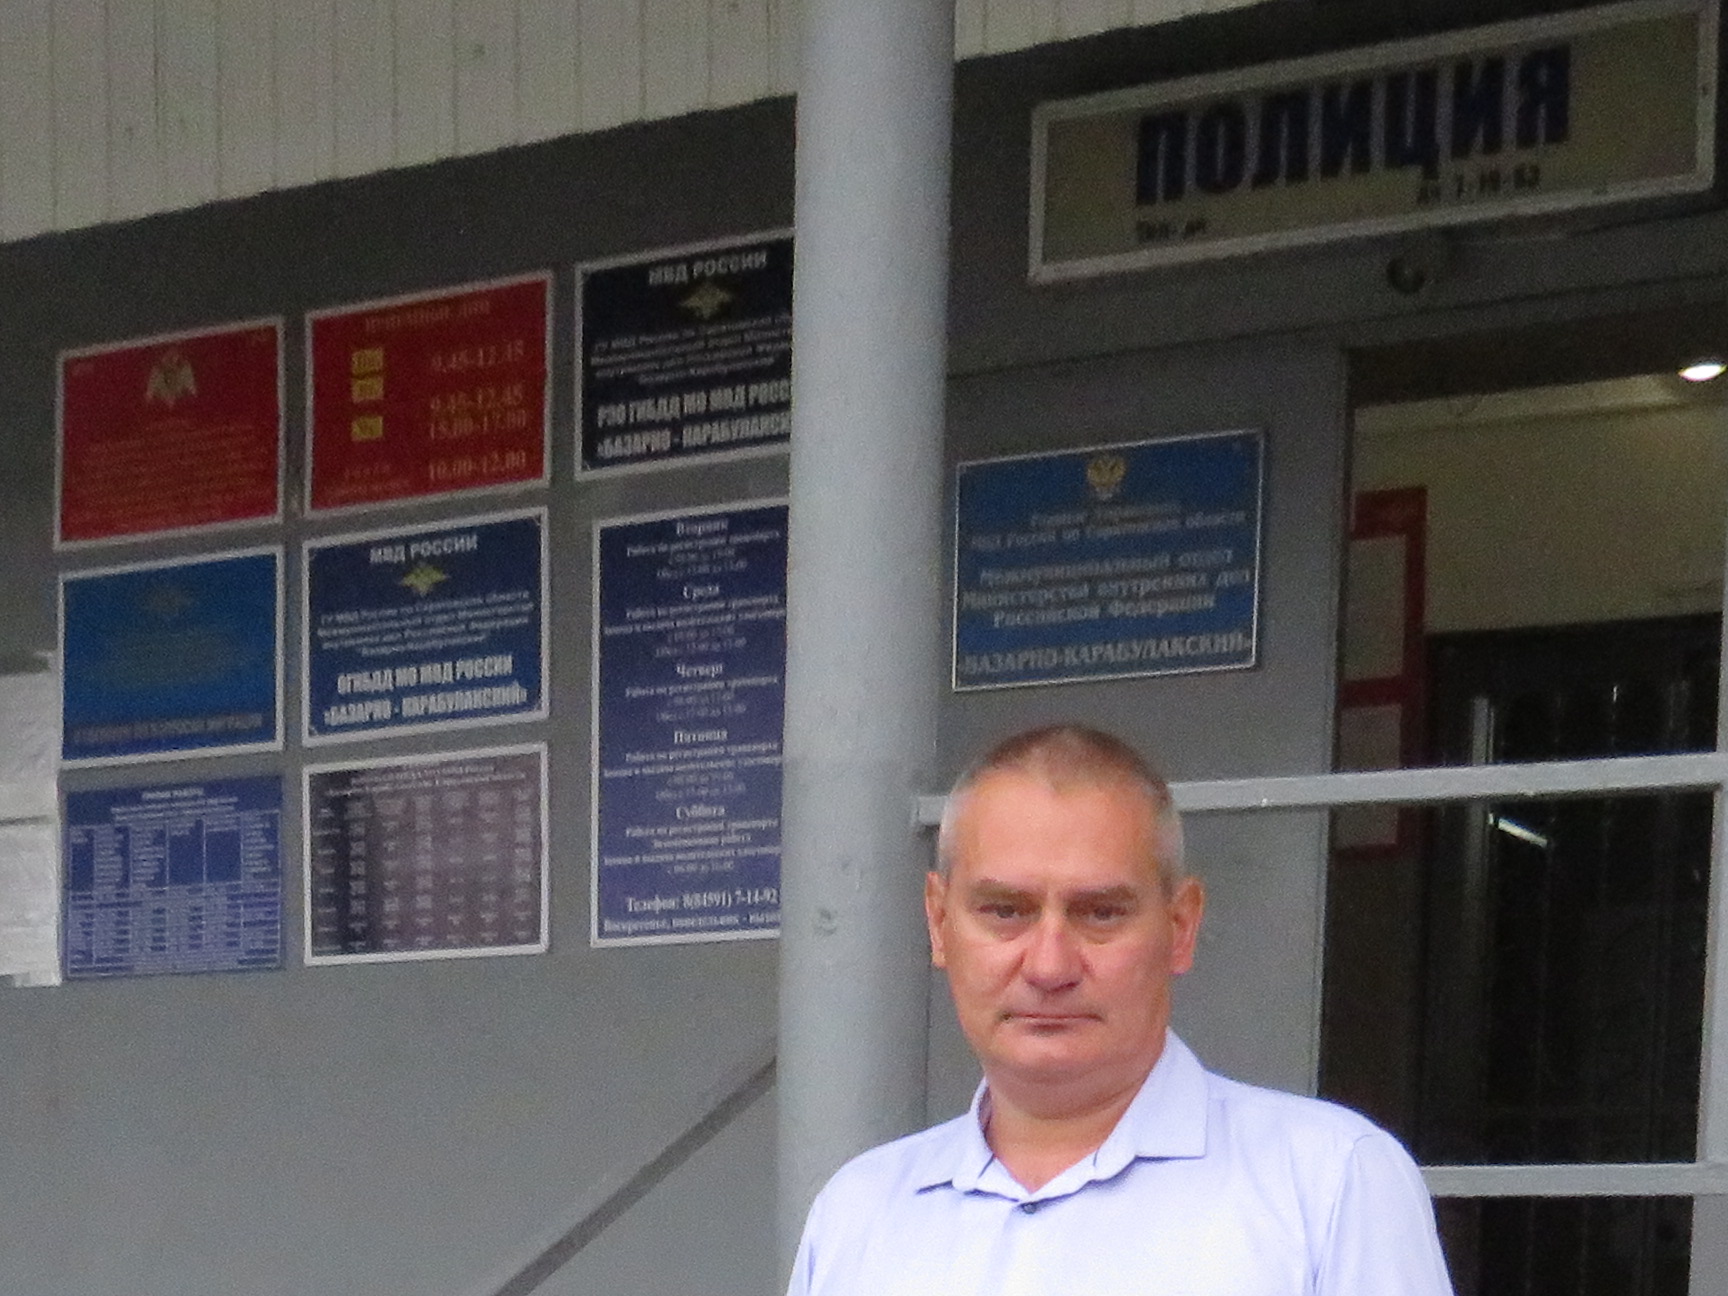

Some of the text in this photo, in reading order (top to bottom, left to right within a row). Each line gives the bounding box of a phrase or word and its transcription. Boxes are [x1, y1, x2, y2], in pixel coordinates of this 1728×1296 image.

[1135, 48, 1572, 207] ПОЛИЦИЯ
[649, 251, 768, 285] МВД РОССИИ
[629, 396, 681, 422] ГИБДД
[683, 391, 707, 414] МО
[709, 384, 746, 411] МВД
[748, 378, 790, 405] РОСС
[369, 534, 478, 564] МВД РОССИИ
[338, 654, 513, 694] ОГИБДД МО МВД РОССИИ
